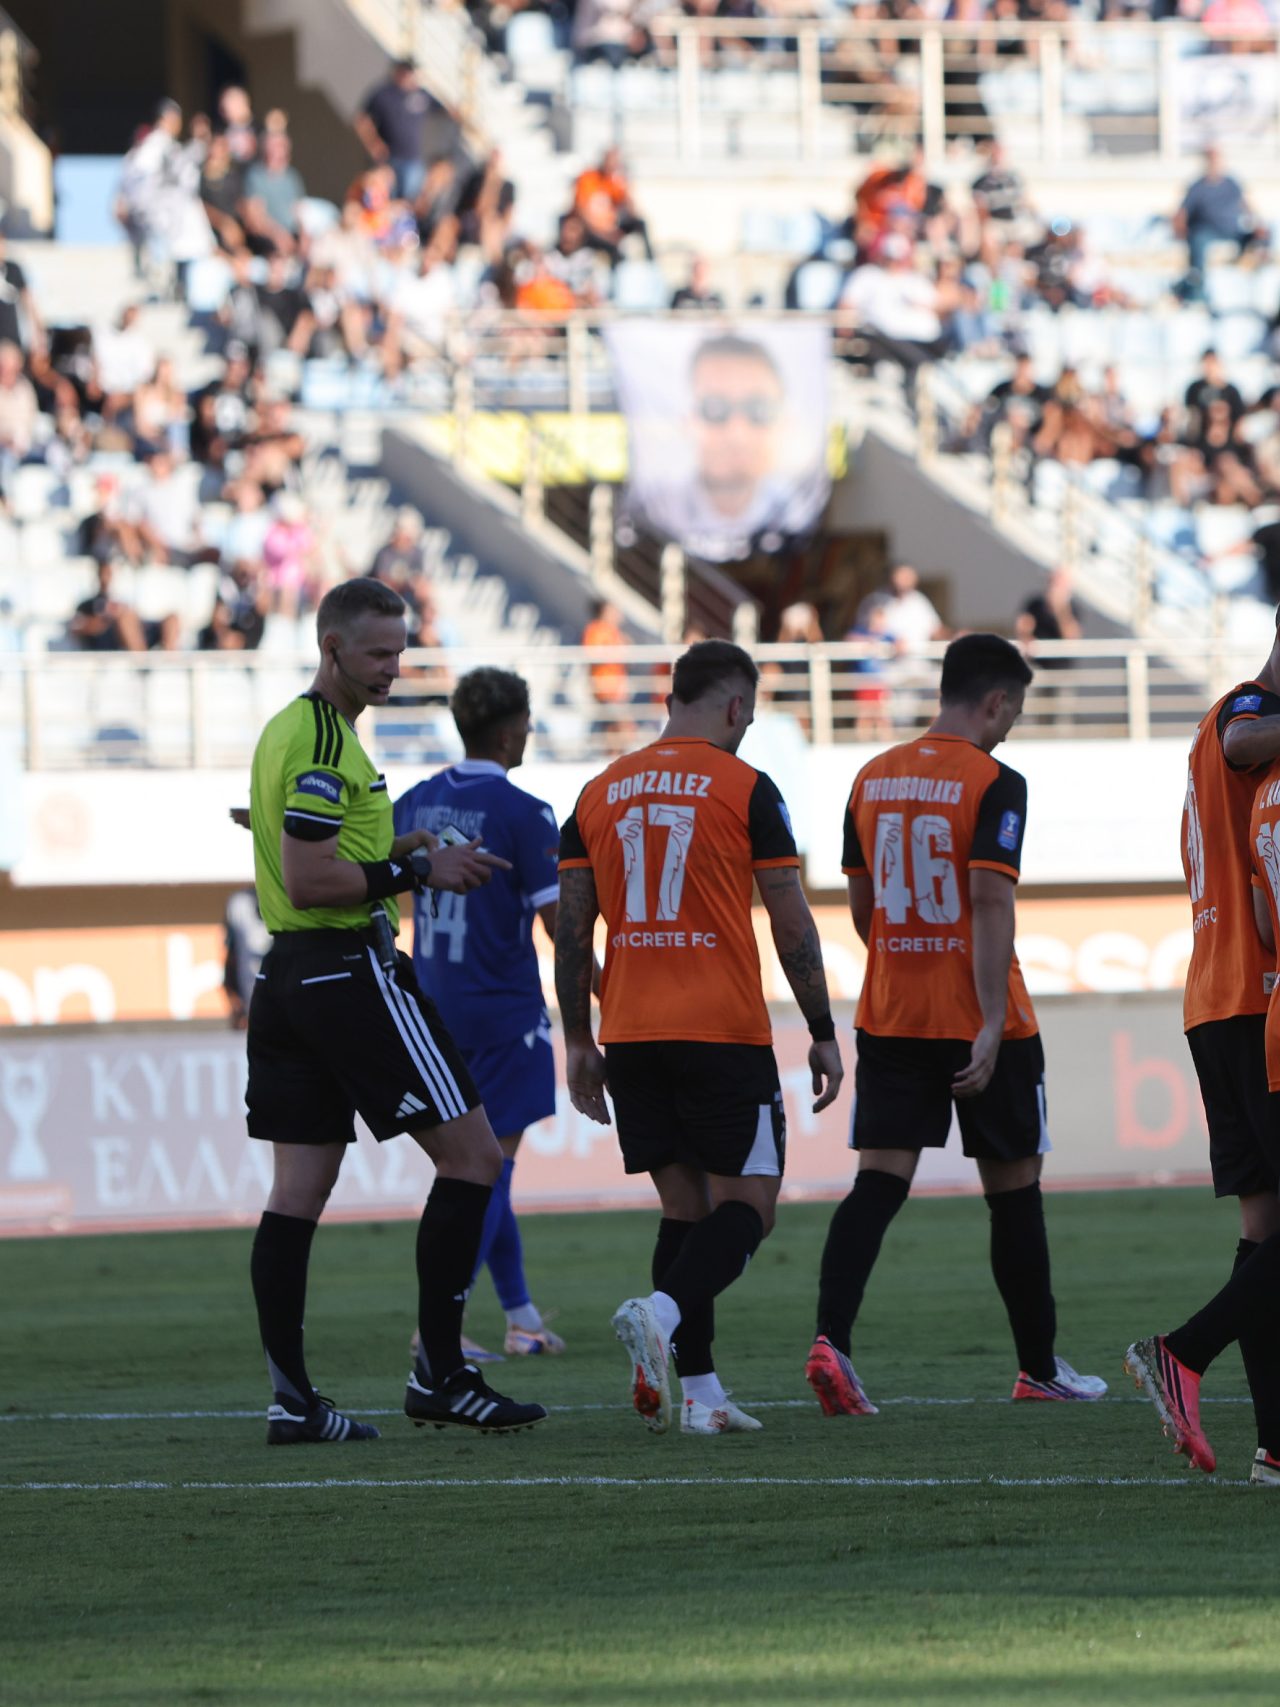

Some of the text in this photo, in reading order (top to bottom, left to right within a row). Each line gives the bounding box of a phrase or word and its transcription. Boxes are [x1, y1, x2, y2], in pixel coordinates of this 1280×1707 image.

[607, 770, 712, 805] GONZALEZ
[615, 803, 695, 923] 17
[872, 813, 961, 925] 46
[629, 932, 686, 947] CRETE
[692, 932, 717, 948] FC
[887, 937, 944, 952] CRETE
